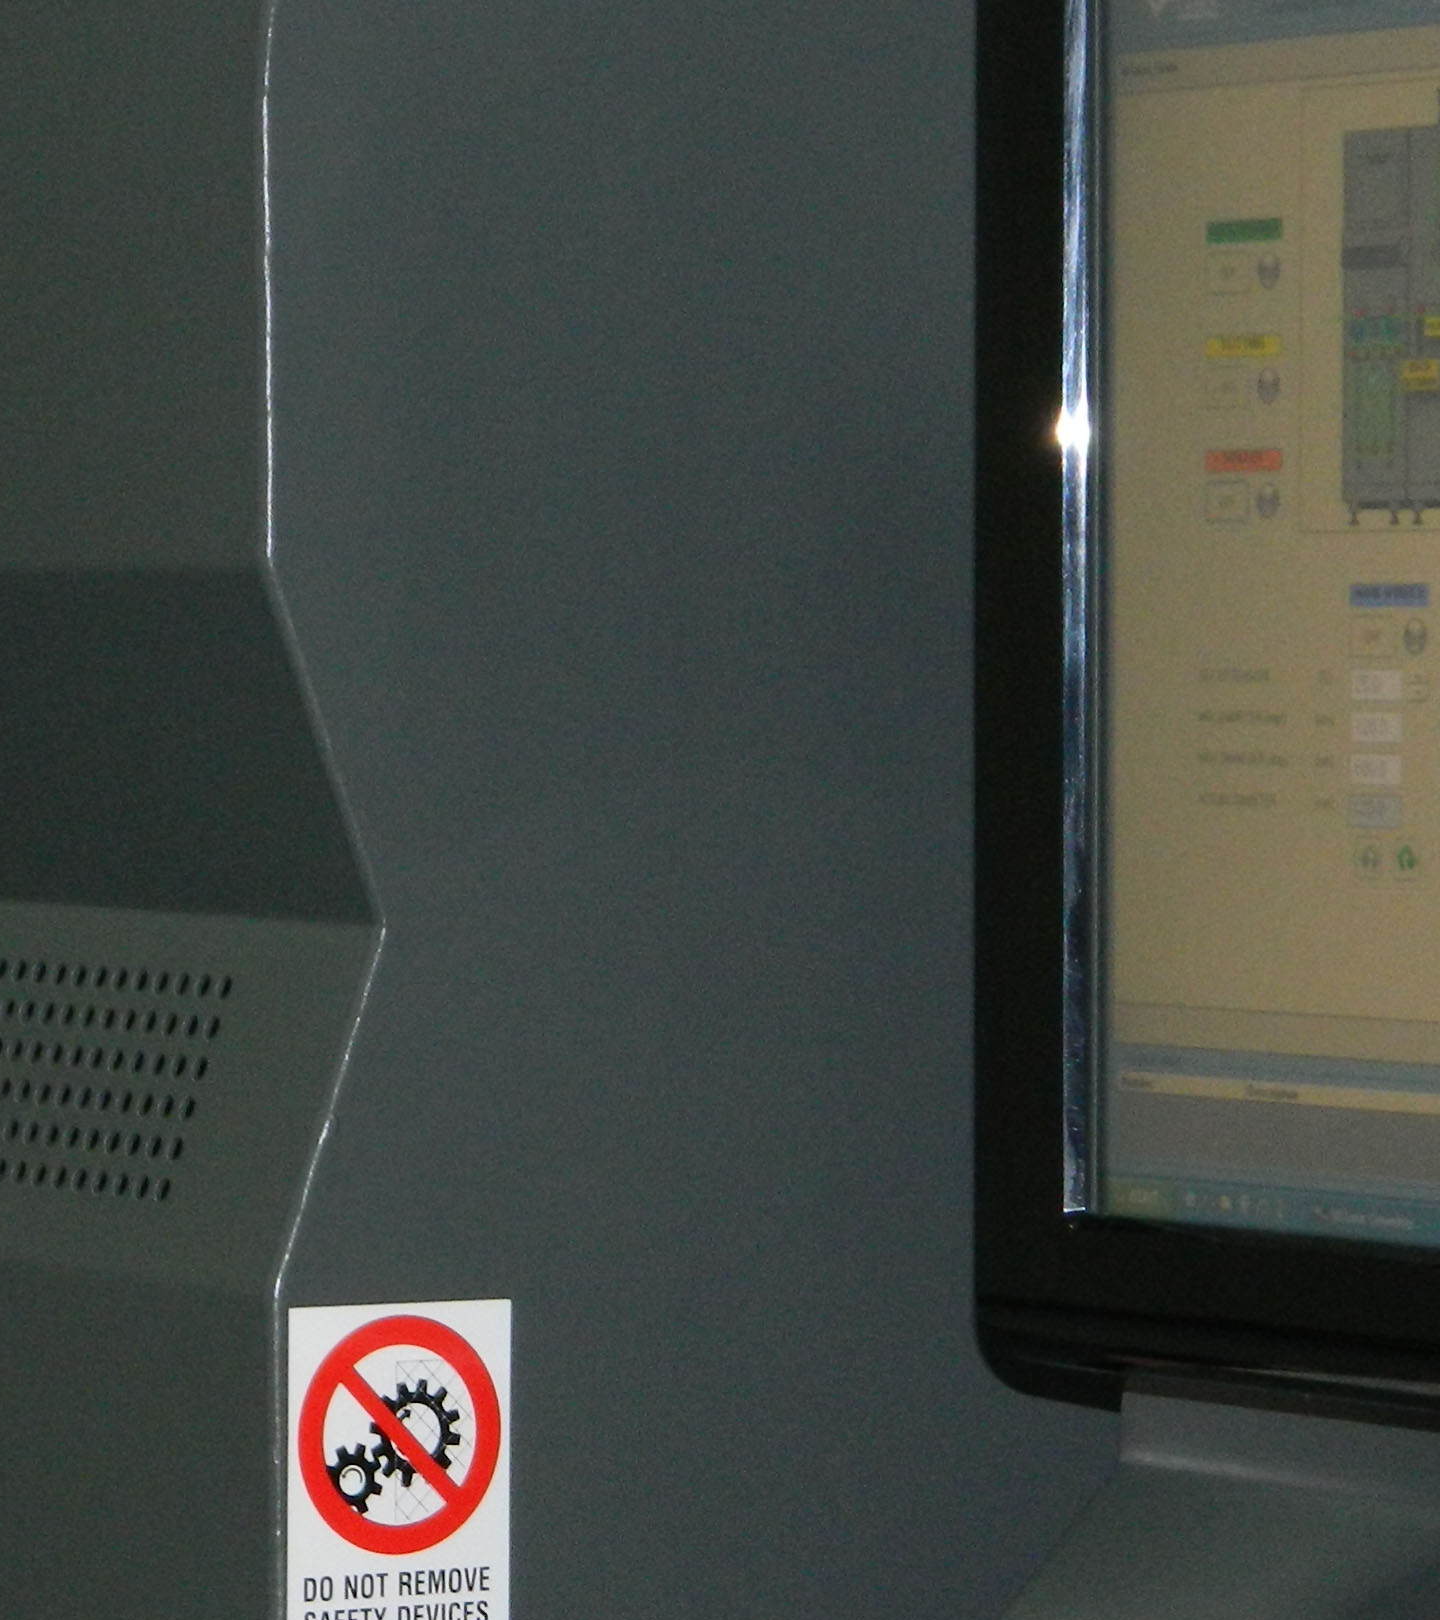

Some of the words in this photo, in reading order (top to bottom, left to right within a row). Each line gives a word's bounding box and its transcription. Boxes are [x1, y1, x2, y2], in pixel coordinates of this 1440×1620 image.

[303, 1576, 334, 1603] DO
[344, 1573, 389, 1600] NOT
[398, 1566, 491, 1597] REMOVE
